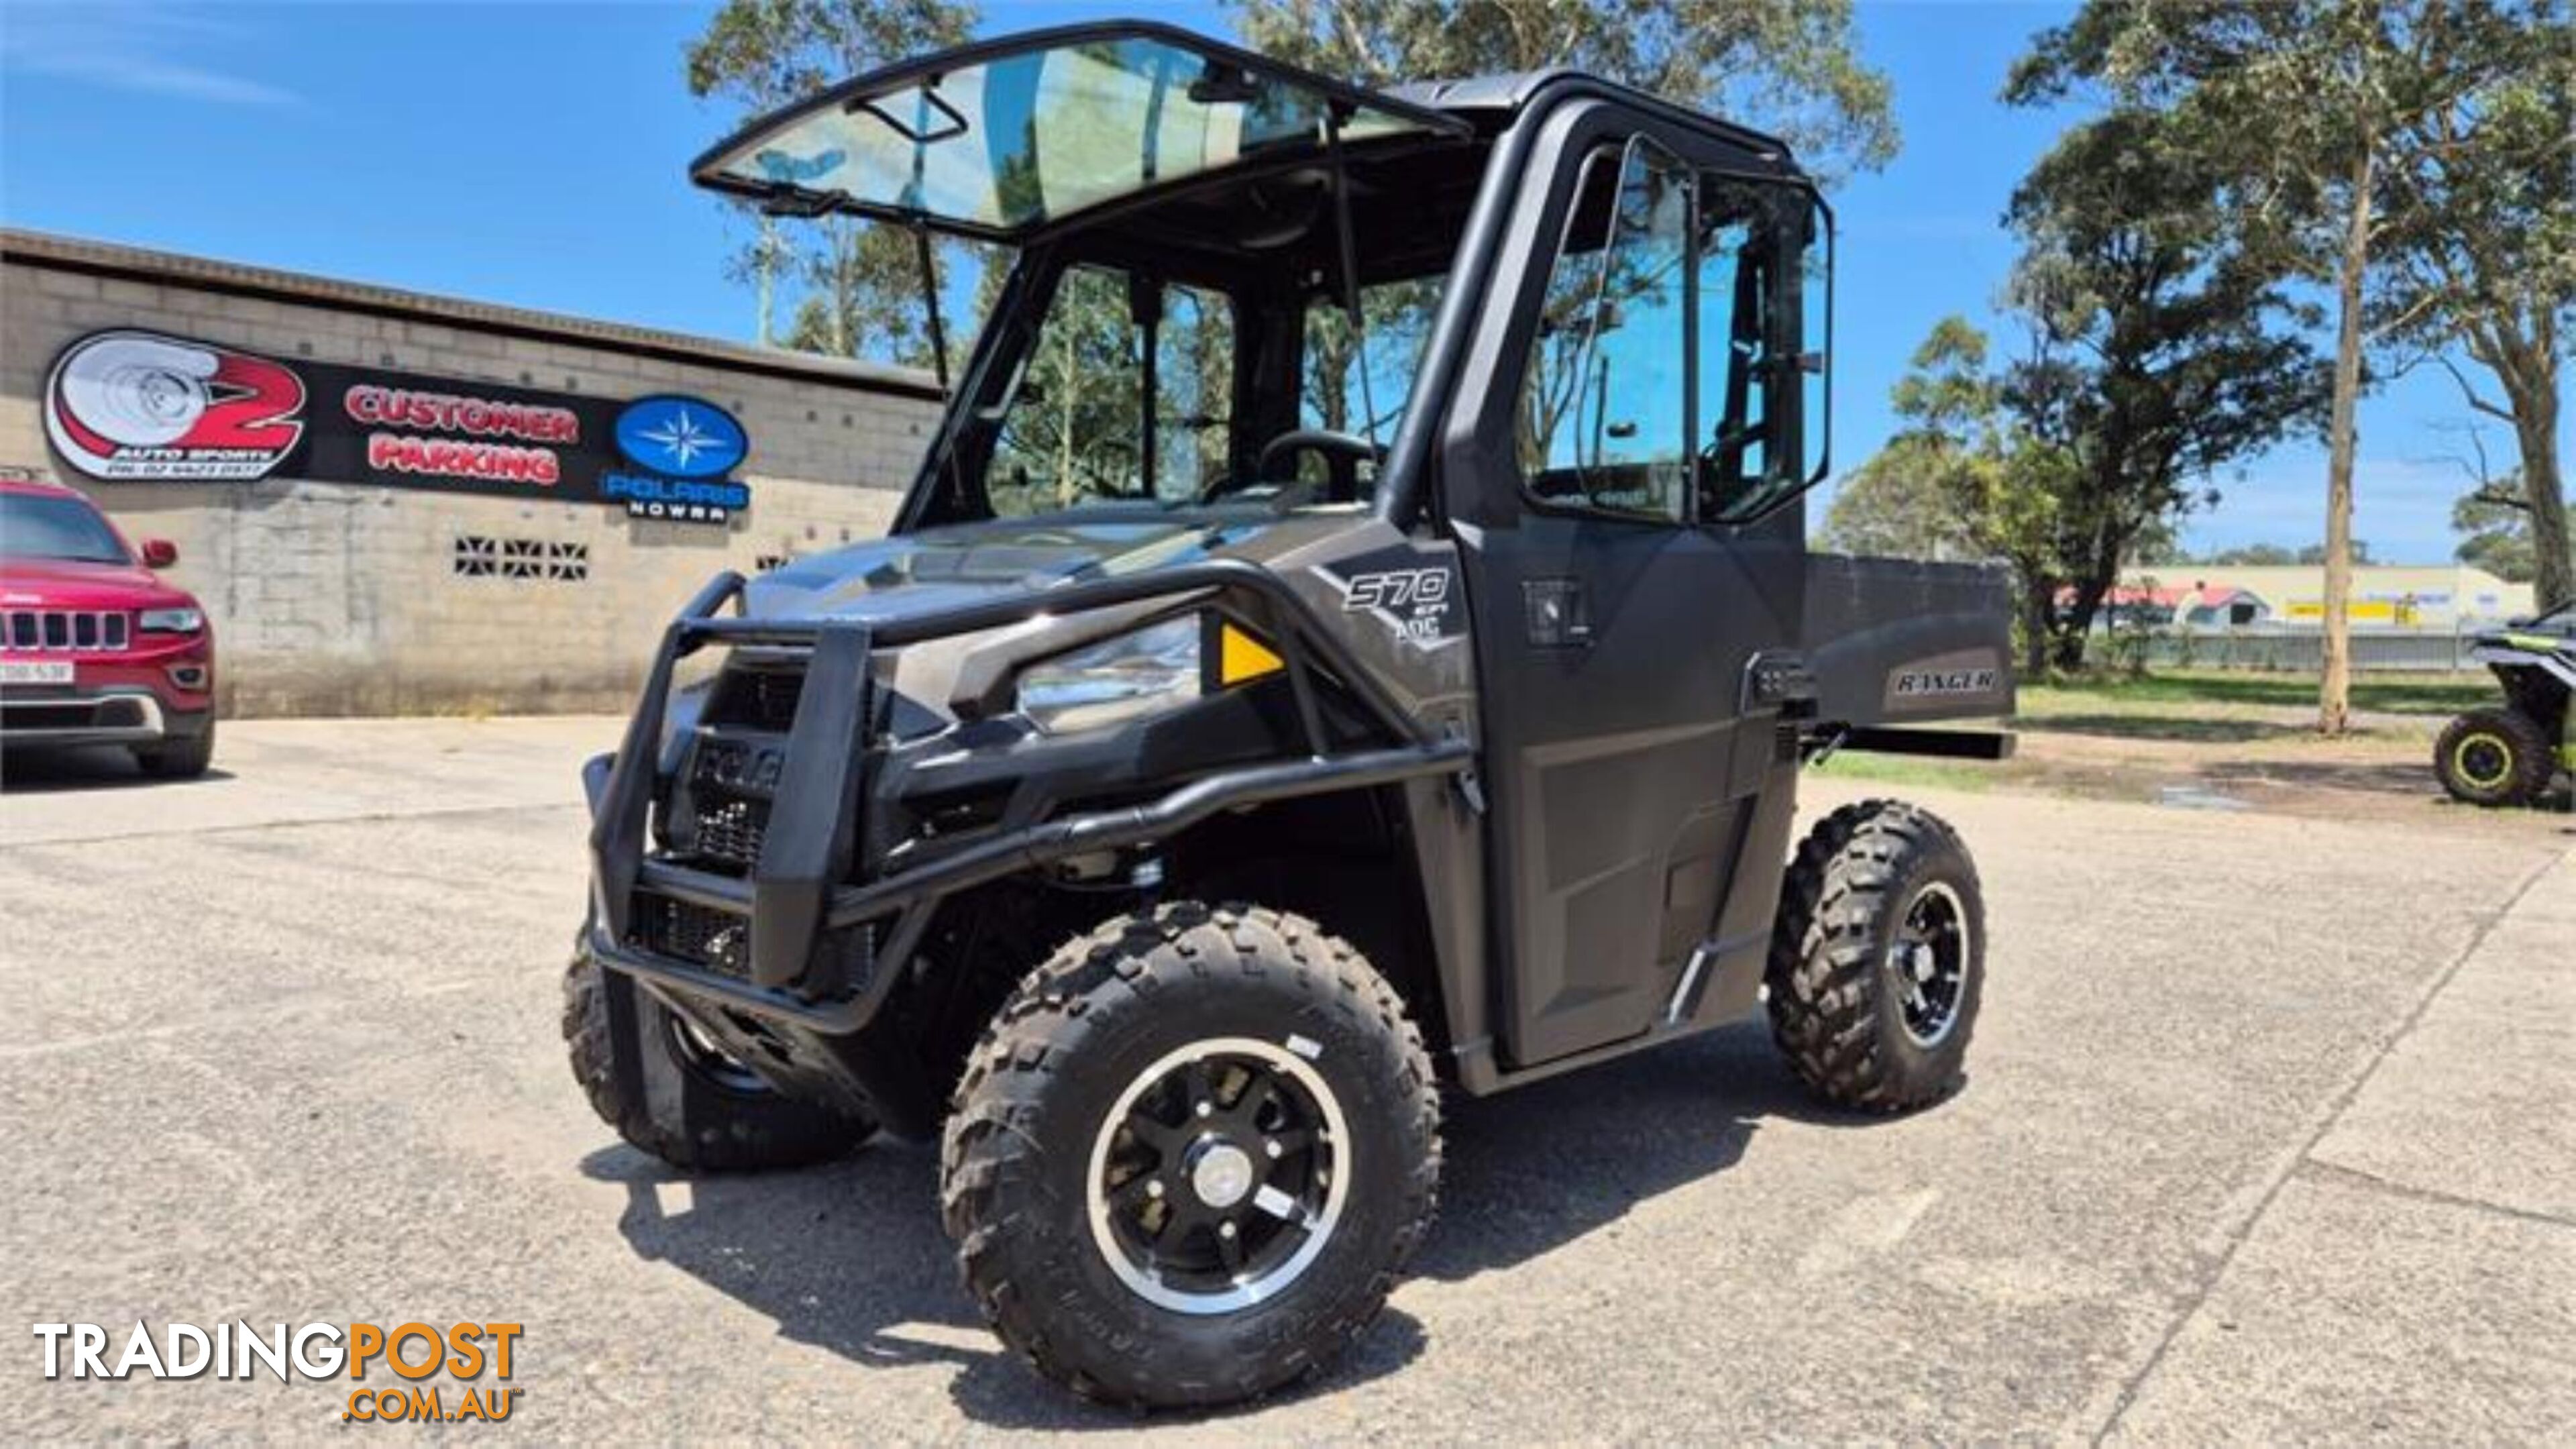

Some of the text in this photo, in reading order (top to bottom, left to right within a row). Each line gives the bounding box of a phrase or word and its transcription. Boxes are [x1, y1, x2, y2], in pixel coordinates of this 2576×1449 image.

[345, 384, 579, 444] CUSTOMER
[112, 449, 273, 461] AUTO SPORTS
[368, 433, 559, 486] PARKING
[604, 474, 746, 504] POLARIS
[630, 502, 724, 520] NOWRA
[1341, 567, 1450, 610] 570
[1896, 672, 1997, 692] RANGER
